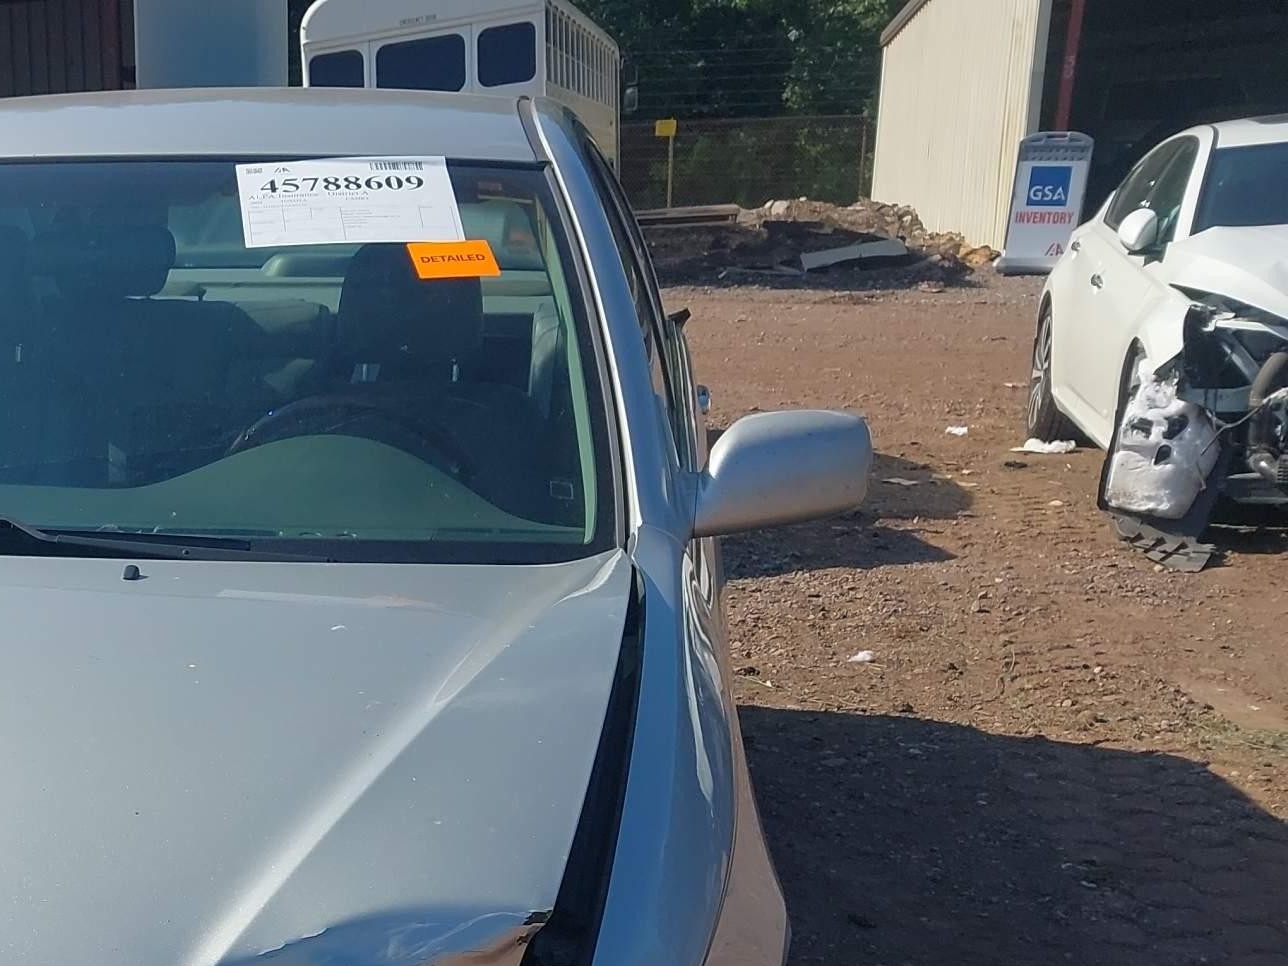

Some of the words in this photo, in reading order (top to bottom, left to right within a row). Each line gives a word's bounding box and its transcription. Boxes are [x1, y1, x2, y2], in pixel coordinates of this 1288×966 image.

[260, 174, 424, 193] 45788609
[1029, 185, 1066, 201] GSA
[1015, 211, 1074, 225] INVENTORY
[420, 253, 486, 264] DETAILED
